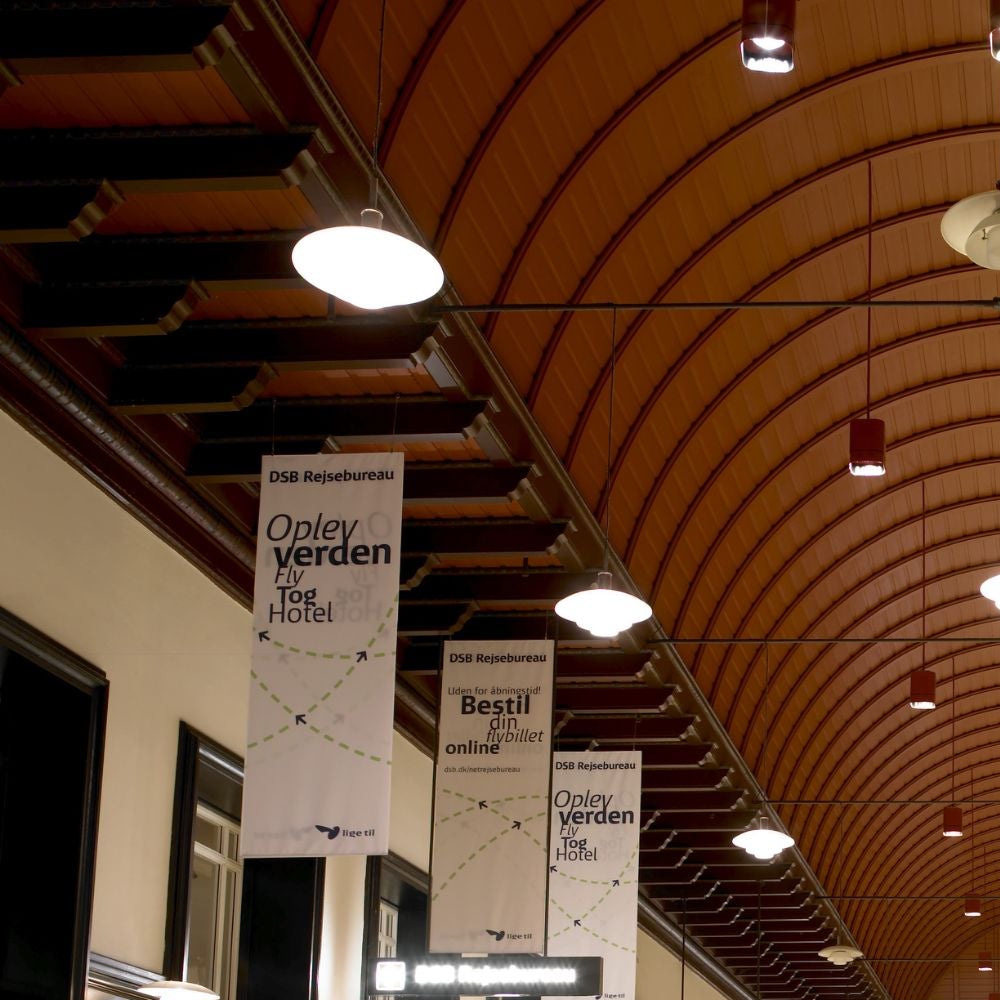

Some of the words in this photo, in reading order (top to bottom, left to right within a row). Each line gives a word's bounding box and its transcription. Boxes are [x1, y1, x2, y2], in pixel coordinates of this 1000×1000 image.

[269, 470, 299, 483] DSB
[303, 469, 395, 485] Rejsebureau
[274, 539, 391, 567] verden
[274, 564, 305, 587] Fly
[276, 585, 317, 606] Tog
[269, 600, 334, 624] Hotel
[450, 653, 473, 664] DSB
[476, 652, 547, 665] Rejsebureau
[448, 686, 472, 696] Uden
[475, 686, 488, 696] for
[461, 694, 530, 715] Bestil
[489, 713, 518, 730] din
[485, 728, 545, 745] flybillet
[445, 739, 500, 755] online
[555, 761, 575, 770] DSB
[578, 761, 636, 772] Rejsebureau
[559, 808, 635, 825] verden
[342, 828, 363, 838] lige
[364, 828, 375, 837] til
[559, 823, 580, 838] Fly
[560, 836, 587, 851] Tog
[556, 846, 598, 861] Hotel
